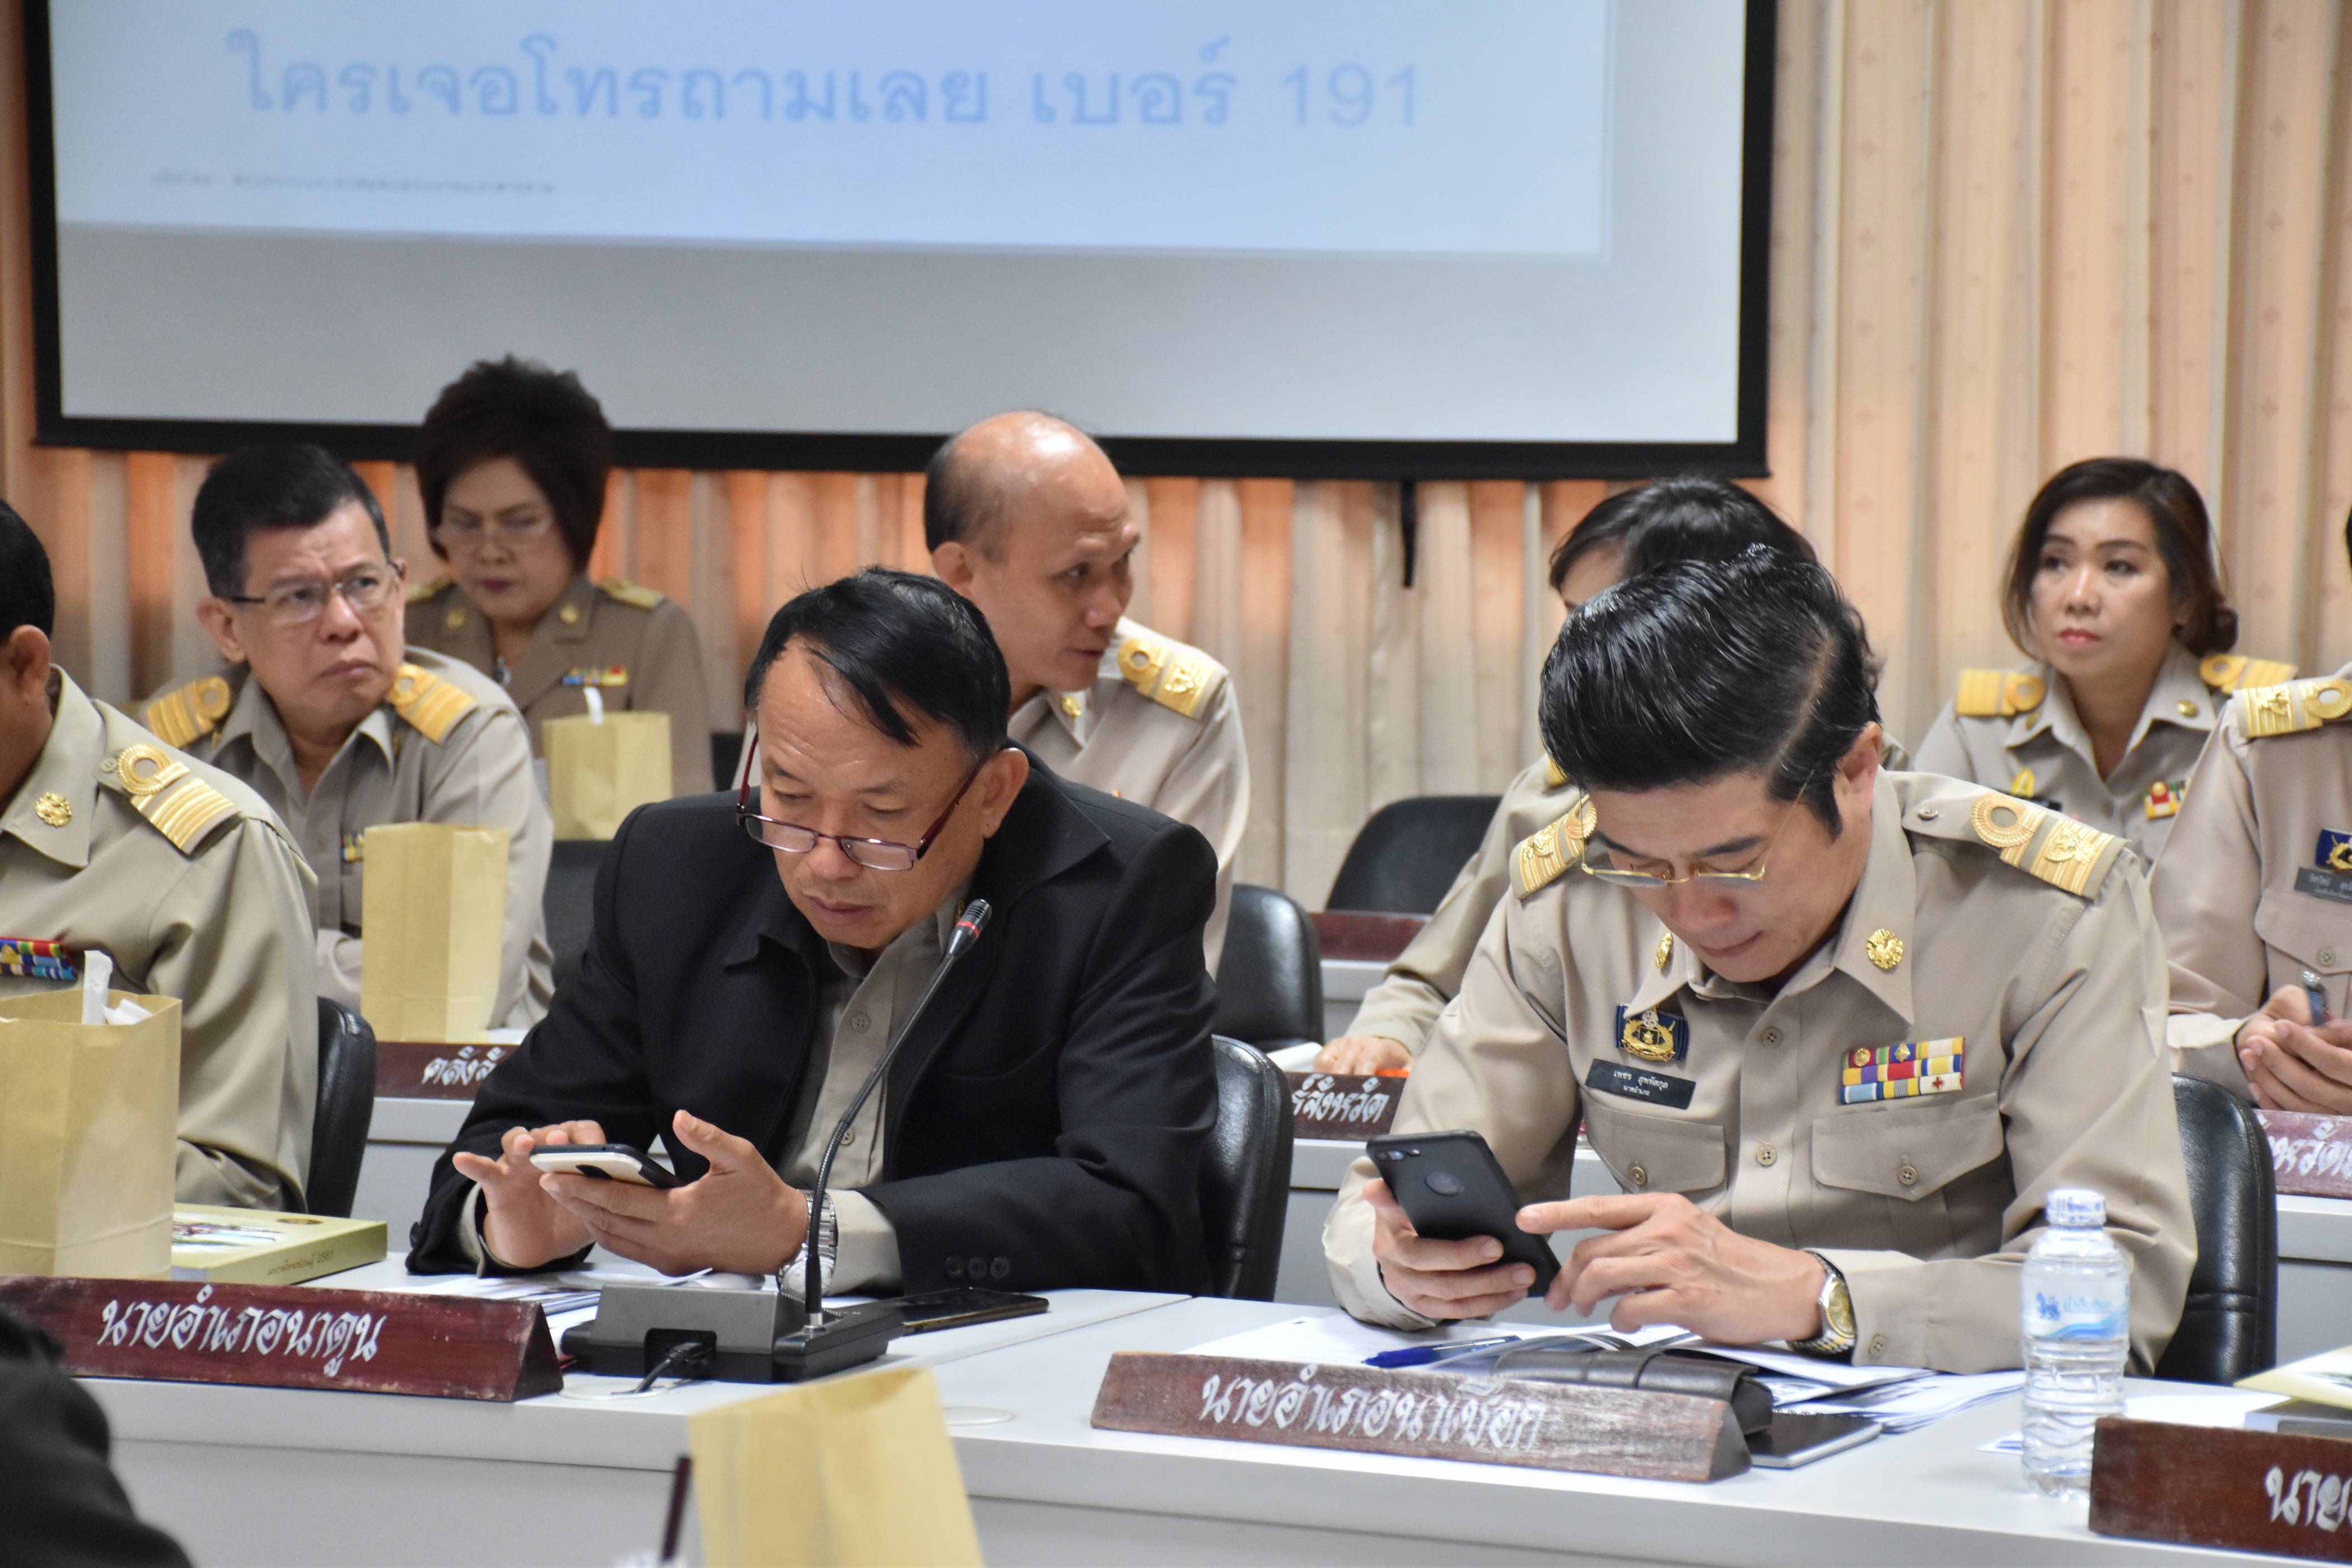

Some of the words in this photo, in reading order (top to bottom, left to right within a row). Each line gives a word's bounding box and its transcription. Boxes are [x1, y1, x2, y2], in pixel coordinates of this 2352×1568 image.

[226, 27, 989, 122] ใครเจอโทรถามเลย
[1032, 35, 1239, 125] เบอร์
[1280, 62, 1419, 128] 191
[96, 1284, 387, 1378] นายอำเภอนาดูน
[1201, 1364, 1547, 1452] นายอำเภอนาเชือก
[2265, 1465, 2352, 1533] นาย
